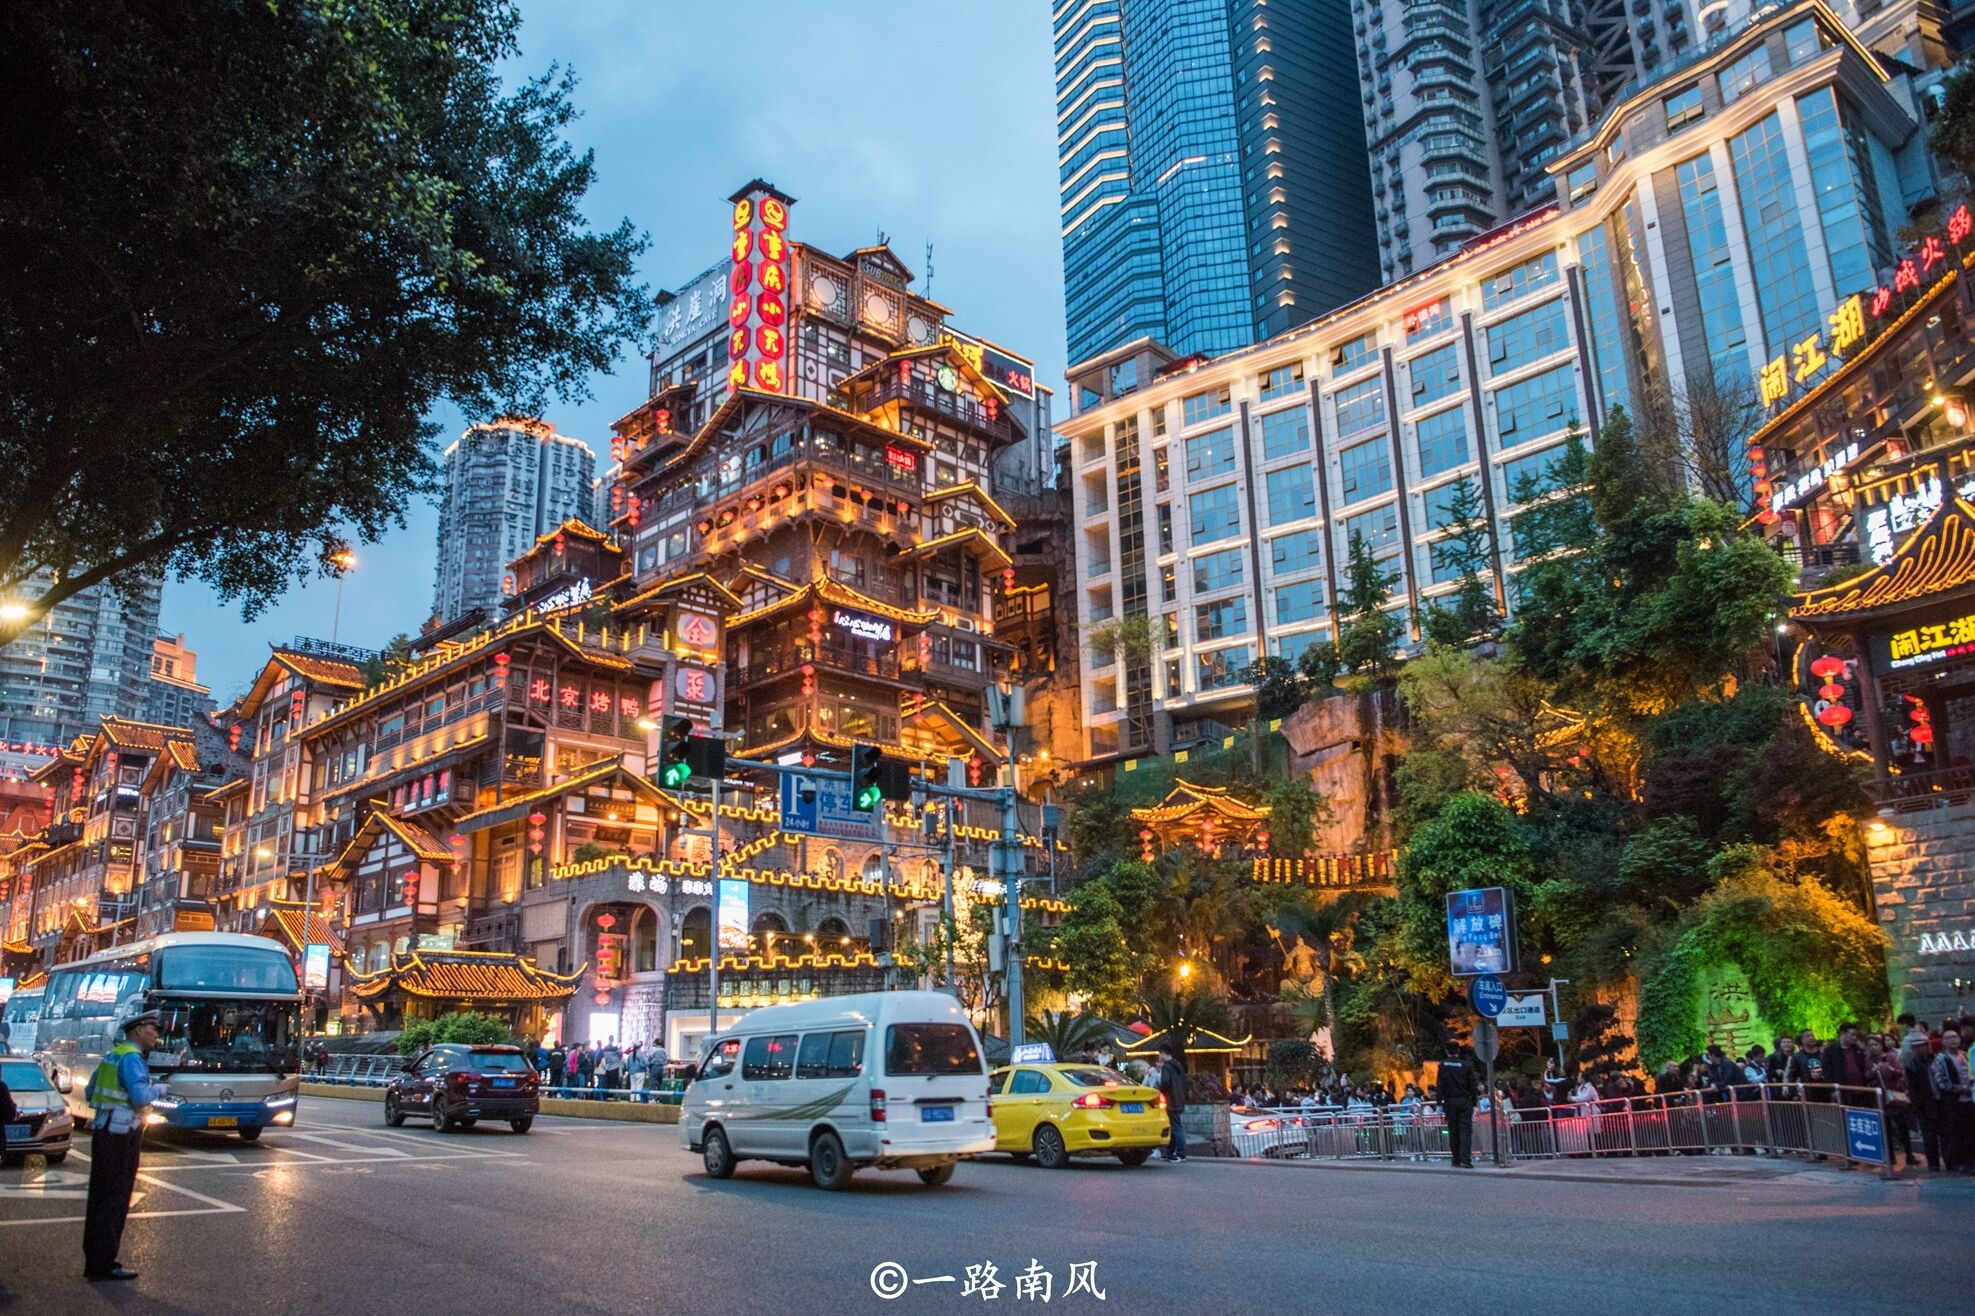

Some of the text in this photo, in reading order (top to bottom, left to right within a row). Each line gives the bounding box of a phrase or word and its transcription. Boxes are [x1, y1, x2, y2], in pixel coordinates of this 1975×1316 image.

[665, 274, 727, 337] 洪崖洞
[1760, 294, 1865, 408] 闹江湖
[1890, 614, 1975, 659] 闹江湖
[530, 679, 641, 718] 北京烤鸭
[820, 791, 852, 815] 停车
[1453, 913, 1503, 934] 解放碑
[1479, 980, 1503, 993] 车库入口
[1479, 991, 1504, 1000] Entrance
[1502, 1006, 1541, 1015] 区出口通道
